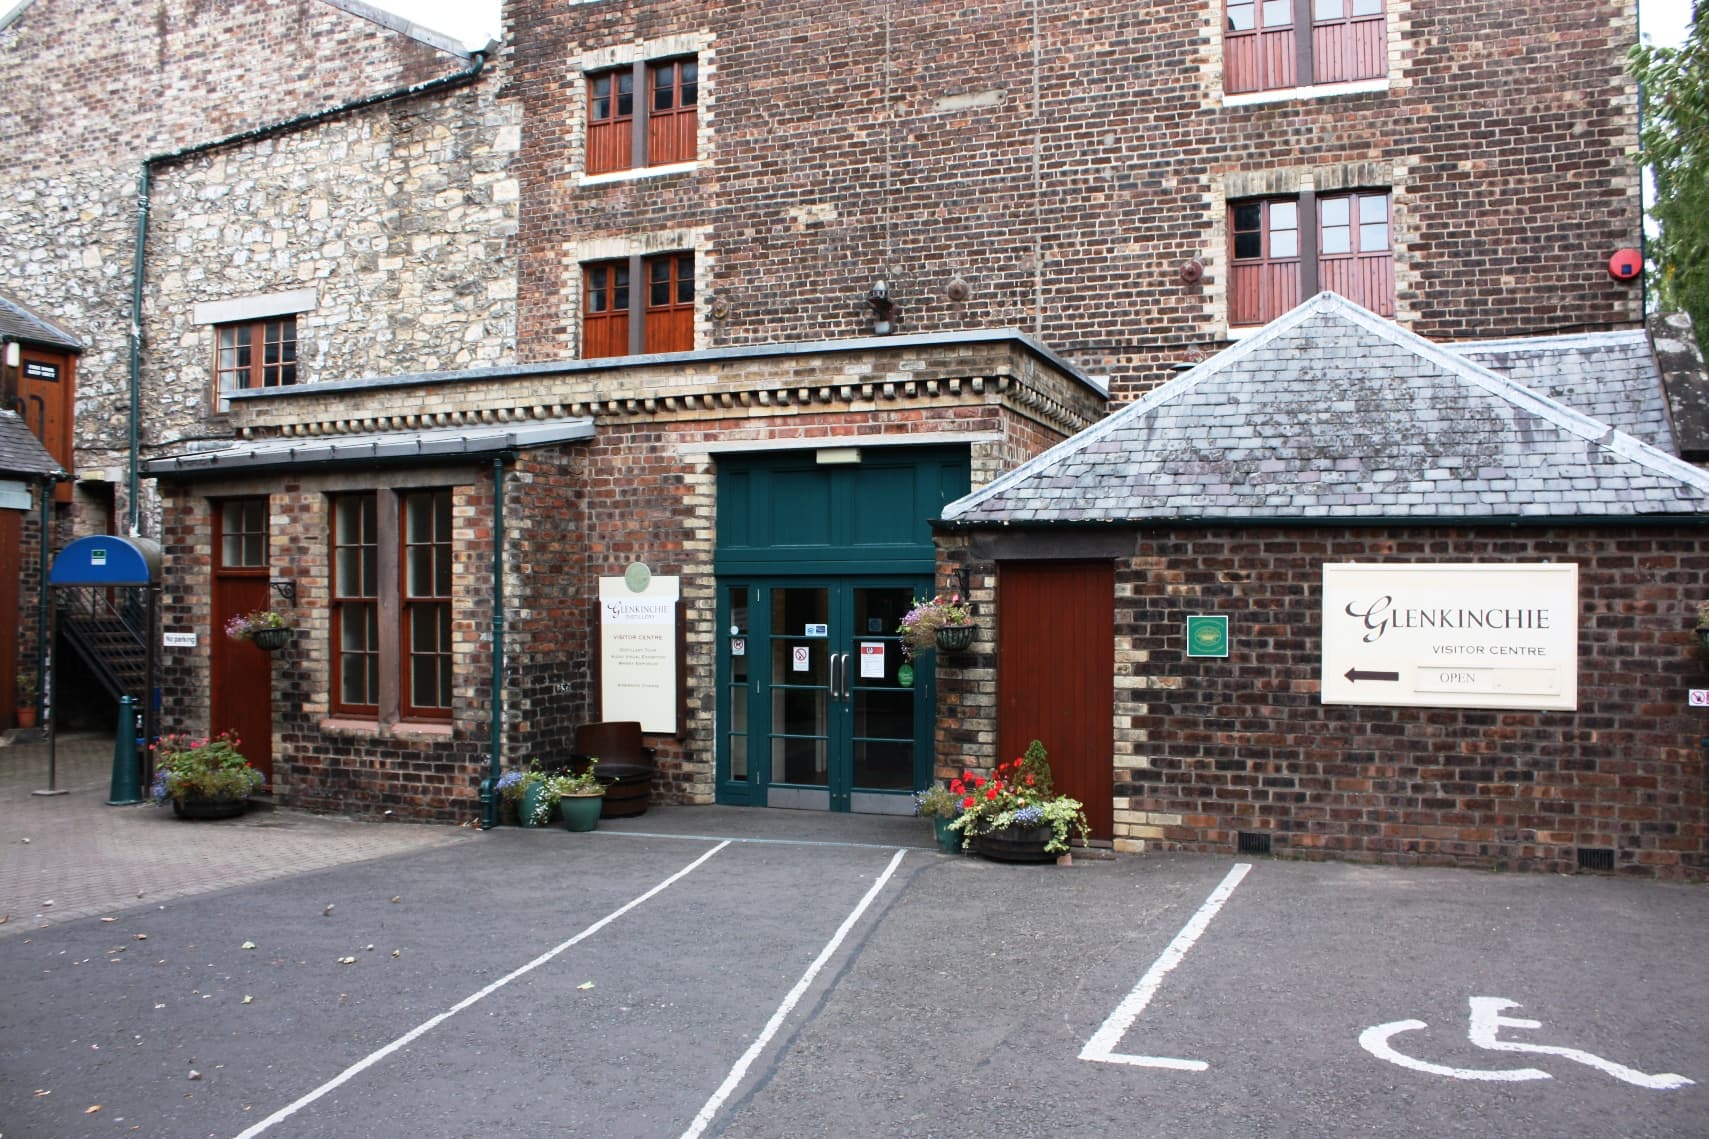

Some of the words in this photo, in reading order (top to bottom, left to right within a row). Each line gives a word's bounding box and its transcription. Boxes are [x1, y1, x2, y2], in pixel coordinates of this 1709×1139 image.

[1345, 595, 1550, 643] GLENKINCHIE
[1432, 645, 1485, 655] VISITOR
[1489, 646, 1547, 656] CENTRE
[1439, 671, 1476, 684] OPEN
